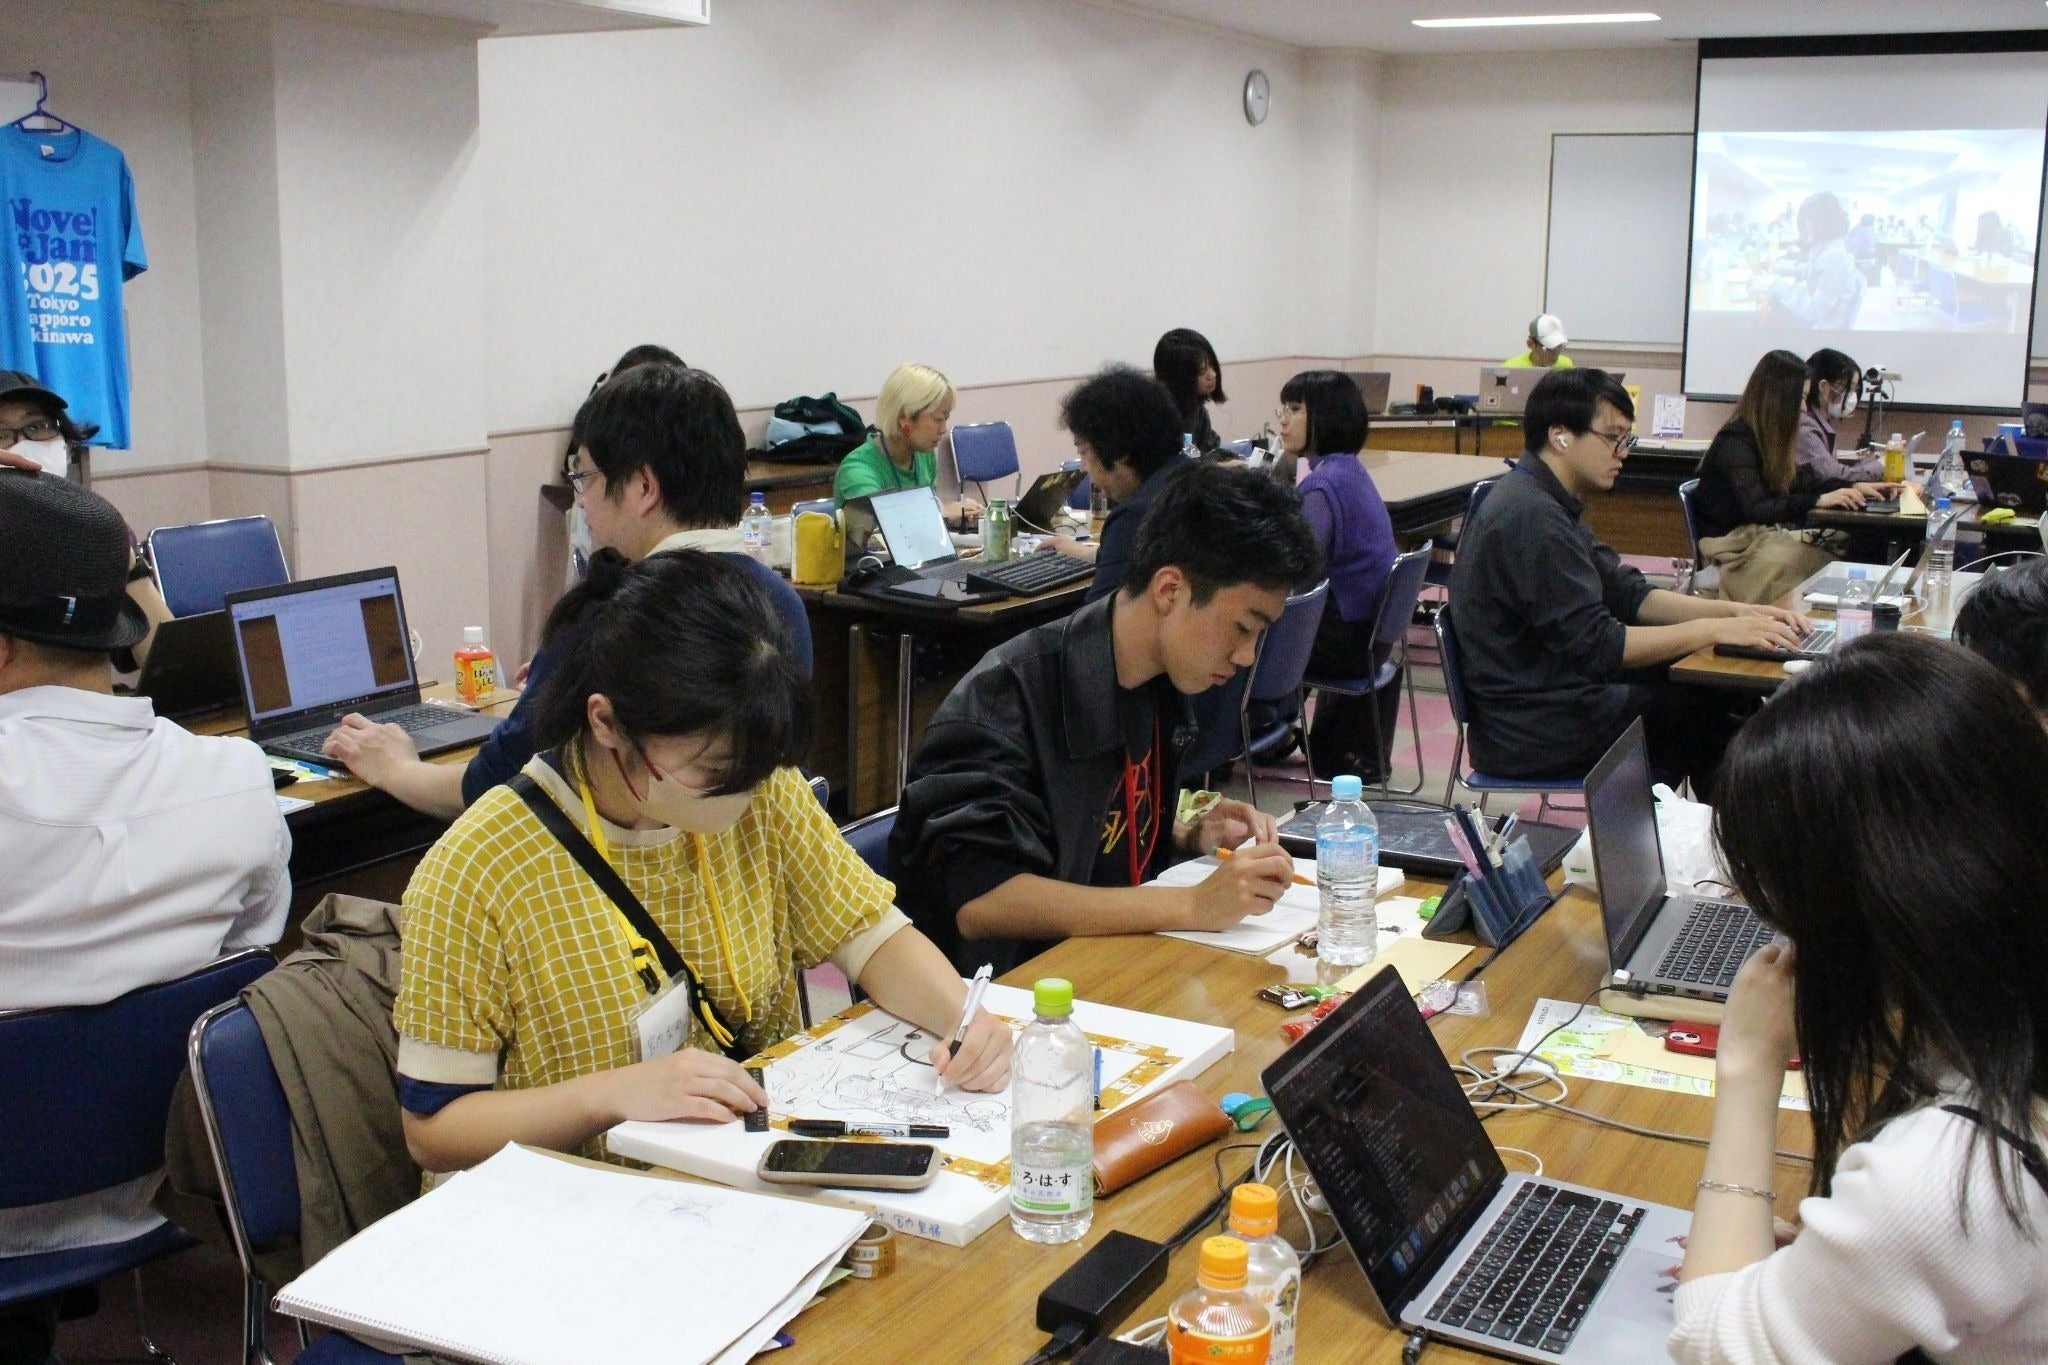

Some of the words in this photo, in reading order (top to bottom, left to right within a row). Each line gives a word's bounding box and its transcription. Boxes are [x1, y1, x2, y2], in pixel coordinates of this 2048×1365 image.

[21, 262, 99, 300] 025
[27, 293, 80, 313] Tokyo
[29, 313, 91, 329] apporo
